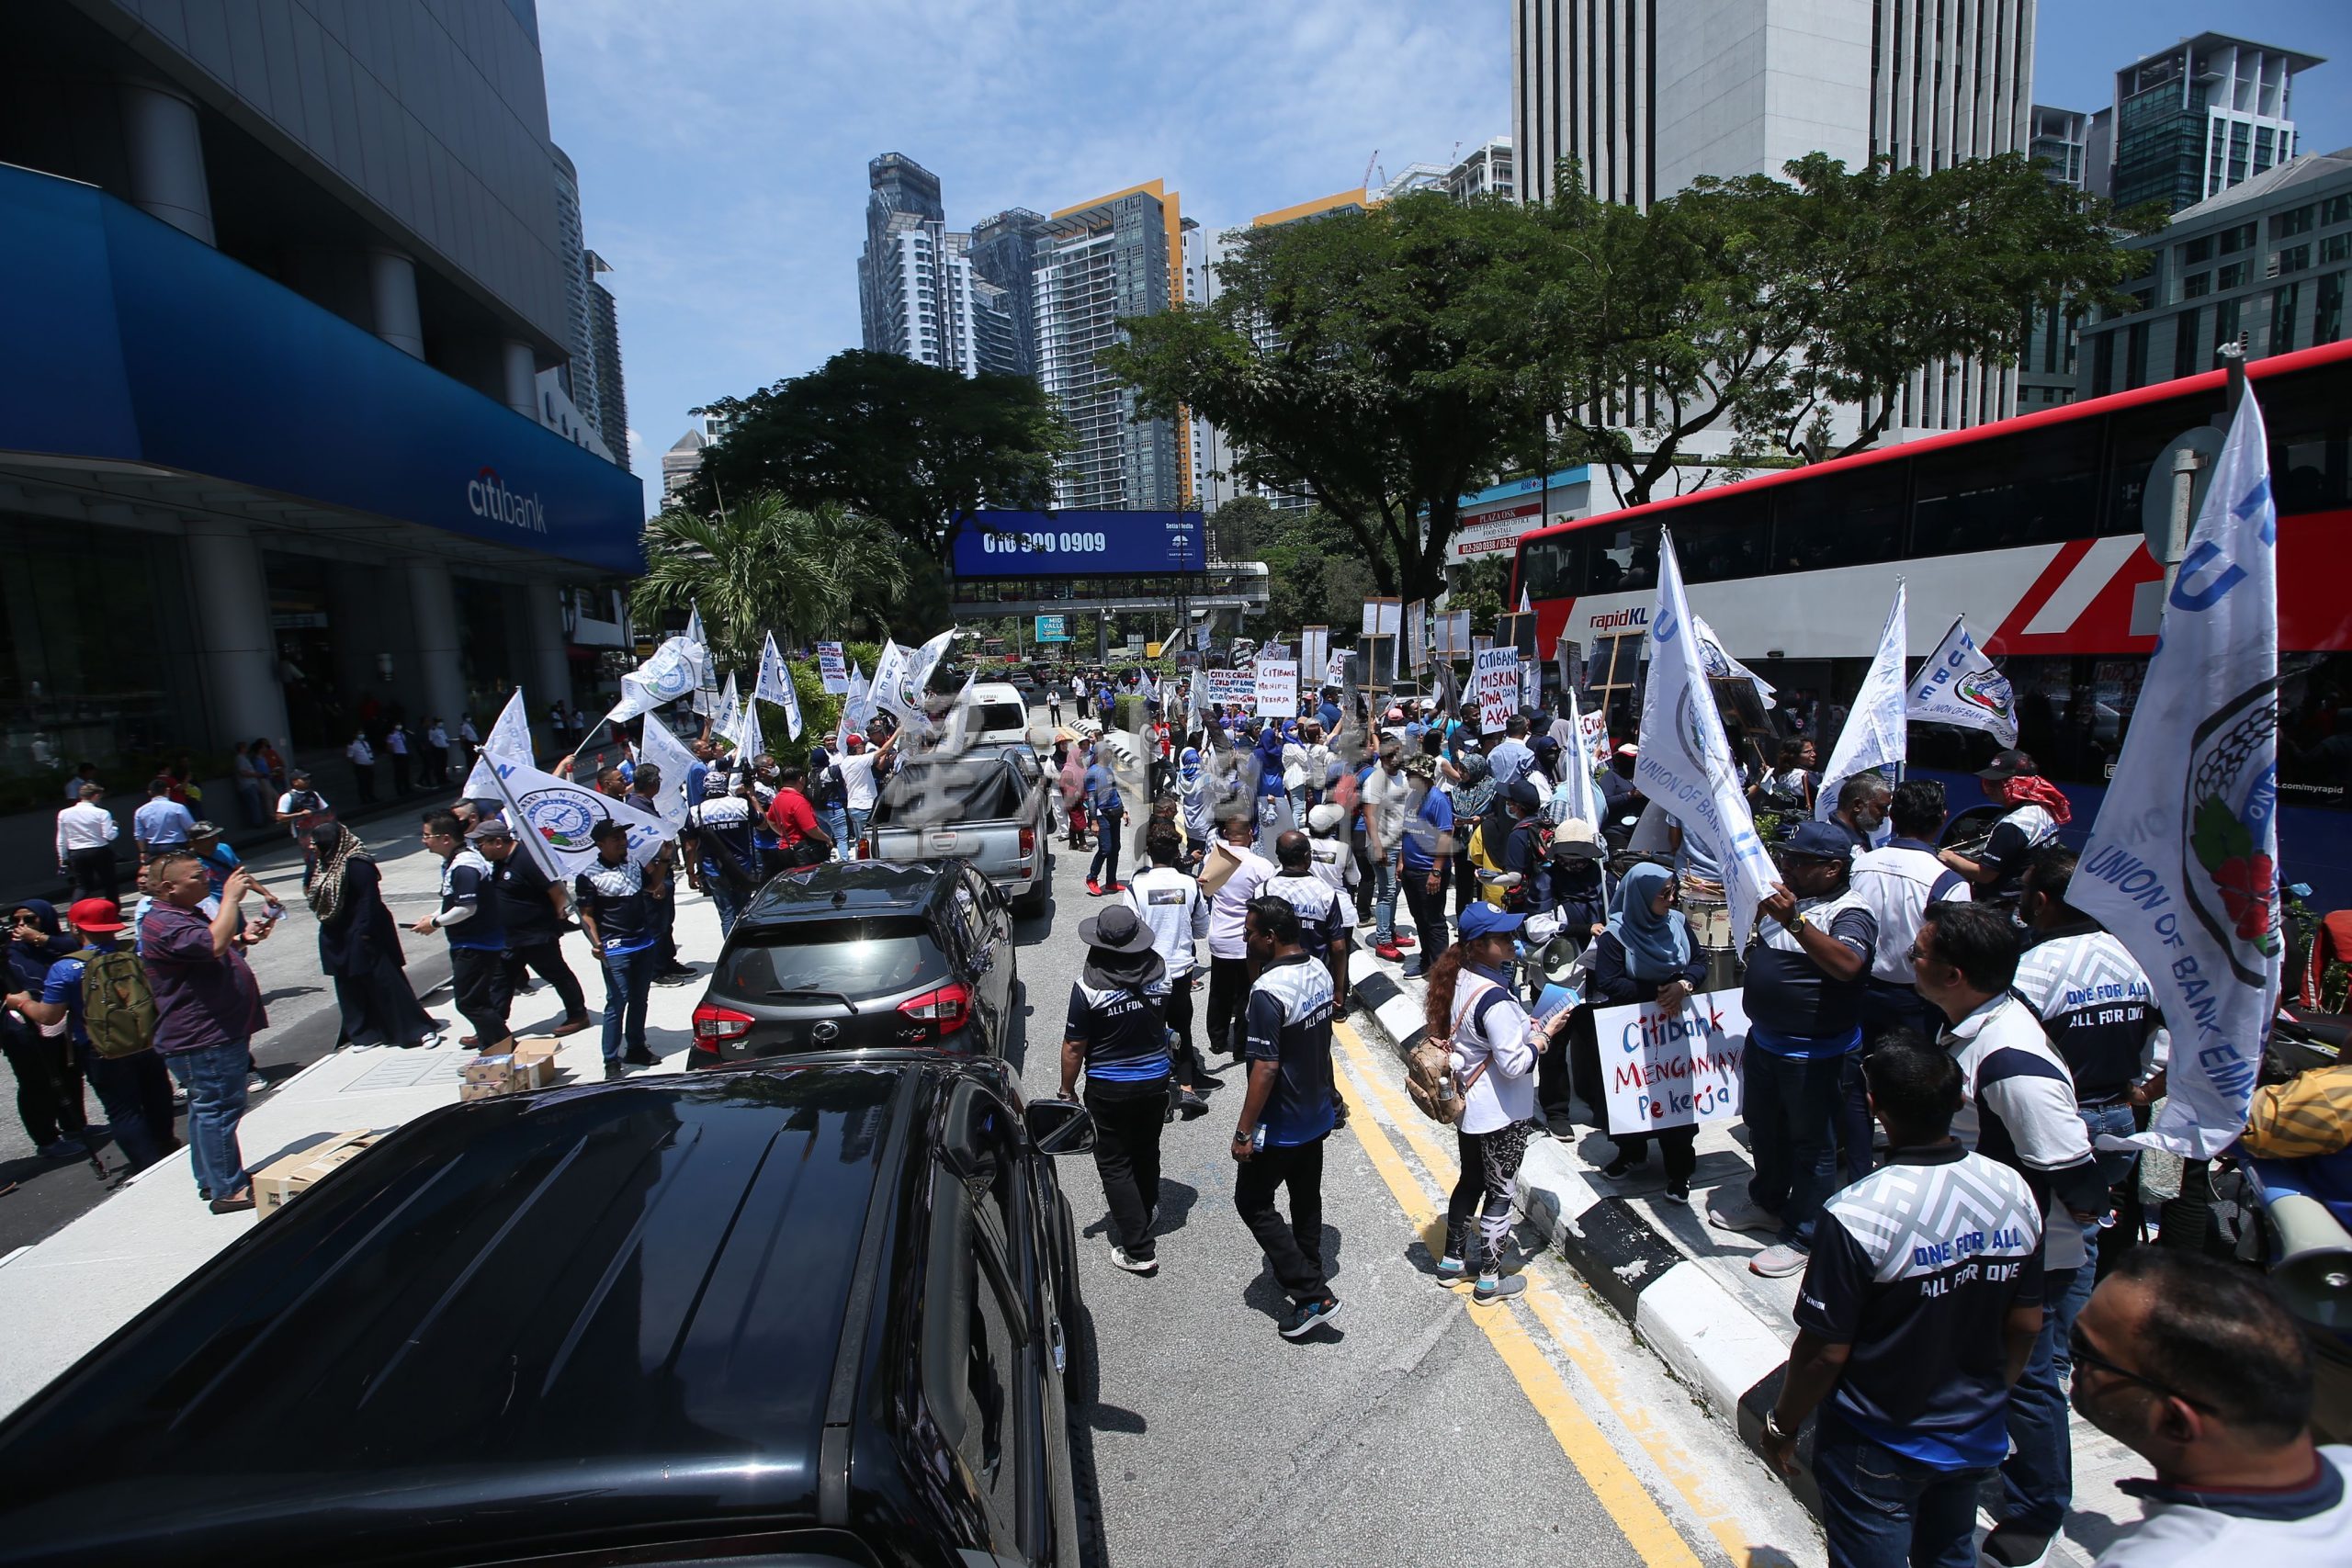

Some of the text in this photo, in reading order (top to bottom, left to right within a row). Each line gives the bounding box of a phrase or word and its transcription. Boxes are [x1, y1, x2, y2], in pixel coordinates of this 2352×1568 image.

[468, 477, 548, 535] citibank
[1479, 509, 1516, 524] PLAZA OSK
[1059, 532, 1105, 552] 0909
[1483, 528, 1497, 536] FOOD
[1589, 607, 1649, 631] rapidKL
[1478, 649, 1519, 670] CITIBANK
[1262, 667, 1296, 678] CITIBANK
[1480, 667, 1518, 689] MISKIN
[1258, 682, 1288, 691] MENIPU
[1479, 687, 1516, 708] JIWA DAN
[1638, 756, 1683, 794] UNION
[1678, 784, 1702, 803] OF
[1301, 904, 1316, 915] ALL
[1301, 919, 1315, 930] ONE
[2084, 845, 2171, 911] UNION
[2154, 913, 2185, 951] OF
[2172, 955, 2222, 1041] BANK
[1314, 989, 1326, 1005] FOR
[2065, 988, 2094, 1005] ONE
[2096, 983, 2123, 999] FOR
[1107, 1005, 1125, 1017] ALL
[1304, 1016, 1316, 1031] ALL
[1316, 1009, 1327, 1023] FOR
[2068, 1012, 2095, 1028] ALL
[2098, 1009, 2125, 1025] FOR
[1622, 1005, 1725, 1055] Citibank
[1914, 1227, 2021, 1267] ONE FOR ALL
[1920, 1262, 2021, 1298] ALL FOR ONE
[1805, 1295, 1826, 1311] UNION
